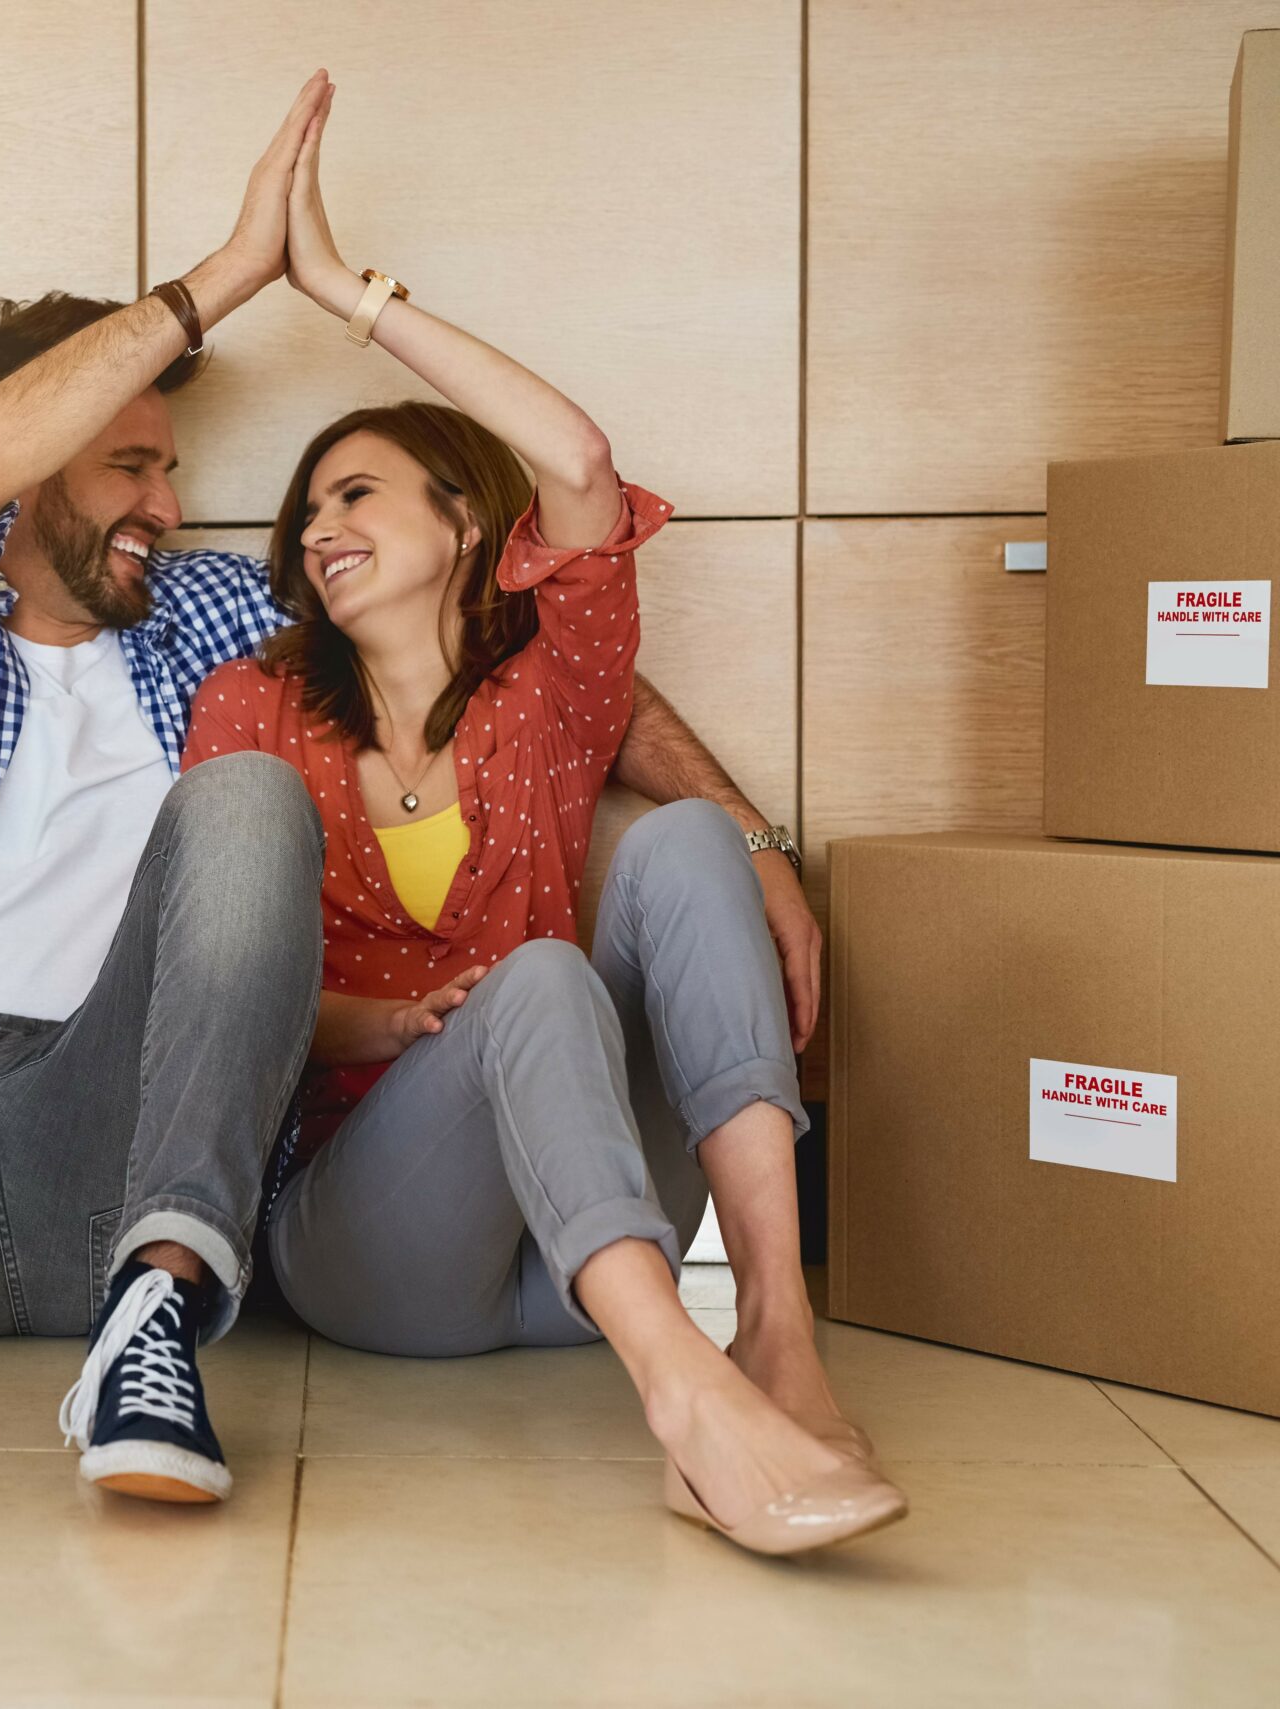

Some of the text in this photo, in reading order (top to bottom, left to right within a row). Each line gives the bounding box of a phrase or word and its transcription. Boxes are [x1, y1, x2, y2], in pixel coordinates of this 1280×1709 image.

[1176, 591, 1243, 608] FRAGILE
[1157, 611, 1262, 623] HANDLE WITH CARE
[1064, 1072, 1143, 1098] FRAGILE
[1041, 1088, 1168, 1117] HANDLE WITH CARE
